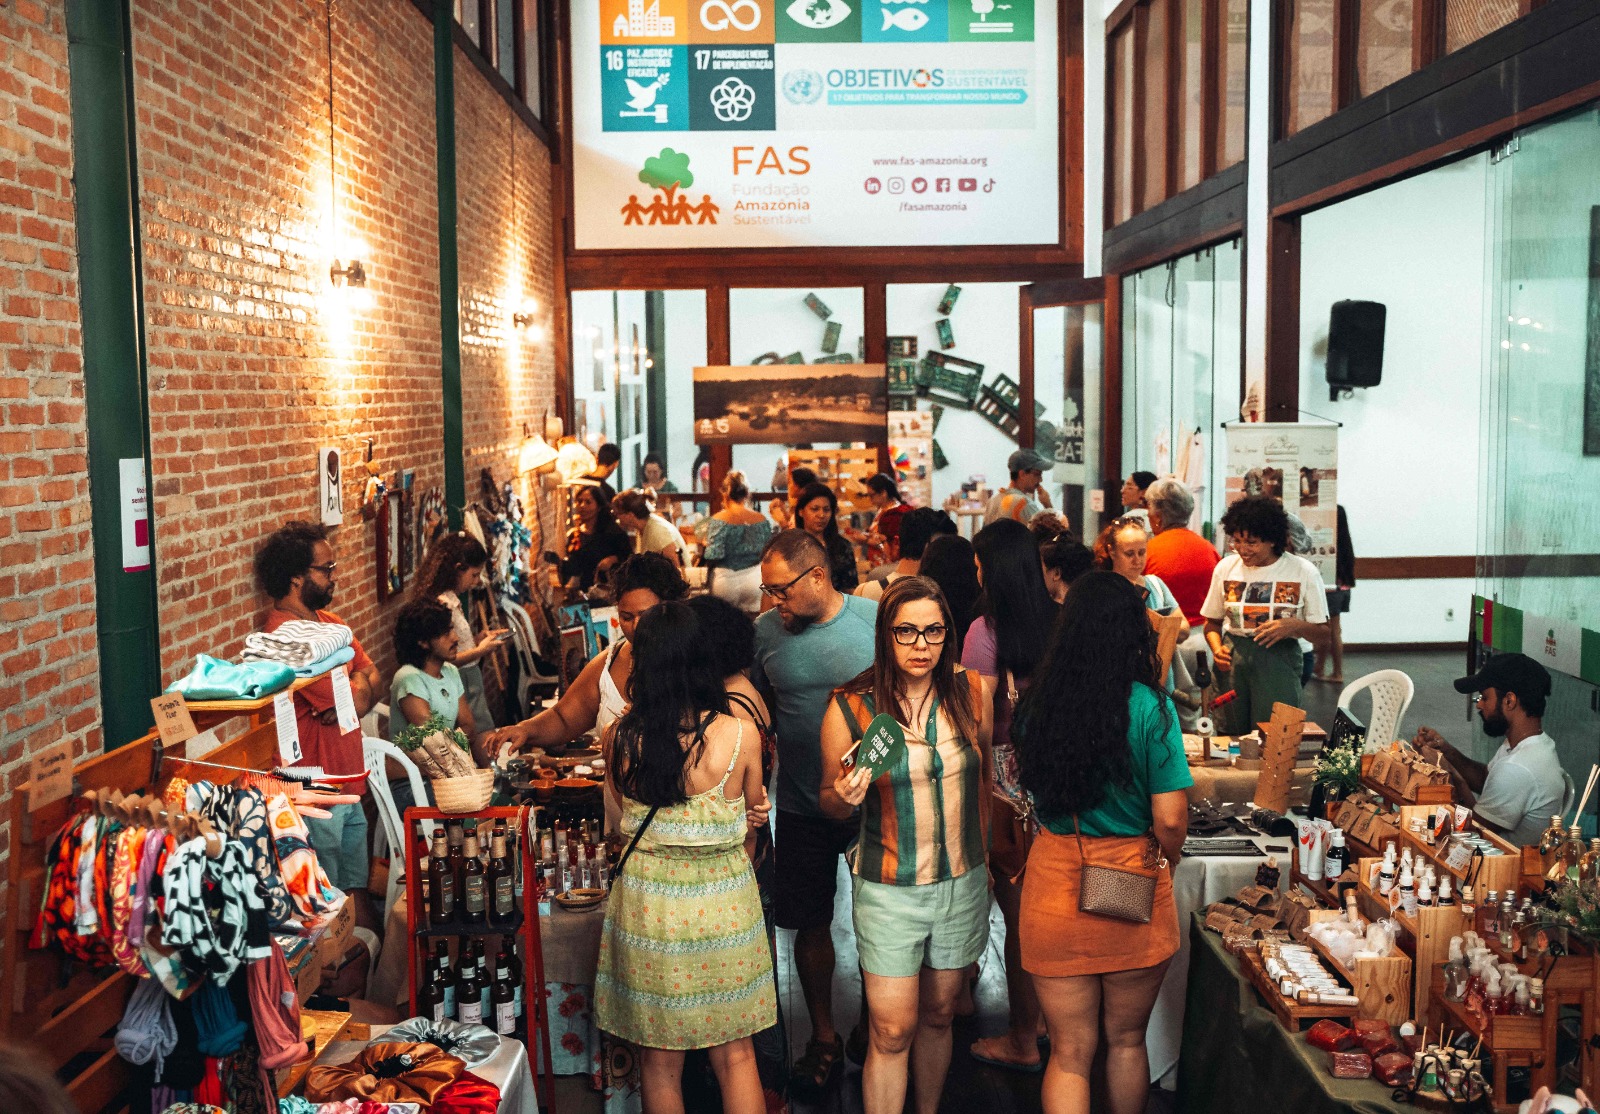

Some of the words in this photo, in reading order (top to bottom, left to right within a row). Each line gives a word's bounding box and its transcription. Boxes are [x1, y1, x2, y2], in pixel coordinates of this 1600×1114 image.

[605, 50, 624, 71] 16
[694, 50, 711, 70] 17
[827, 68, 945, 88] OBJETIVOS
[733, 146, 811, 175] FAS
[872, 156, 988, 167] www.fas-amazonia.org
[733, 182, 810, 198] Fundação
[734, 198, 810, 211] Amazônia
[899, 202, 967, 212] /fasamazonia
[1544, 646, 1556, 657] FAS
